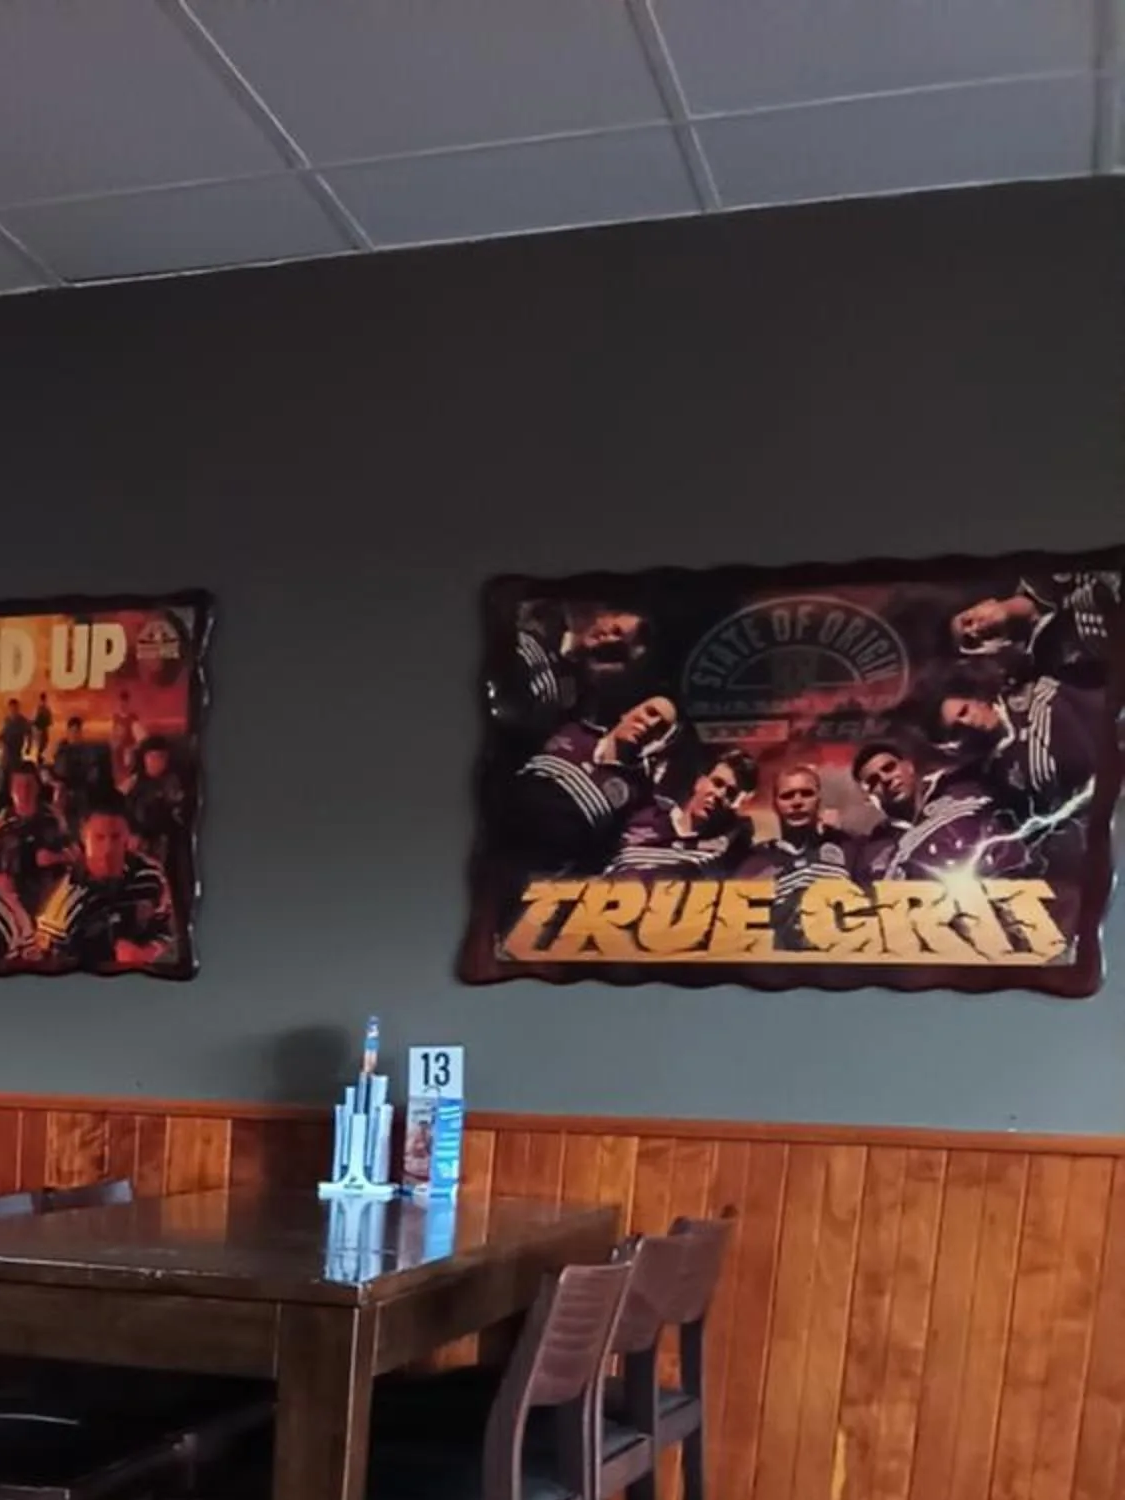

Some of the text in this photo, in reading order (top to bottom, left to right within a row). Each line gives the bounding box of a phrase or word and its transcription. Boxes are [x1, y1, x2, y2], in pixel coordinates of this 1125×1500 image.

[51, 622, 127, 690] UP
[690, 604, 900, 688] STATE OF ORIGIN
[505, 876, 1065, 962] TRUE GRIT
[421, 1052, 451, 1087] 13
